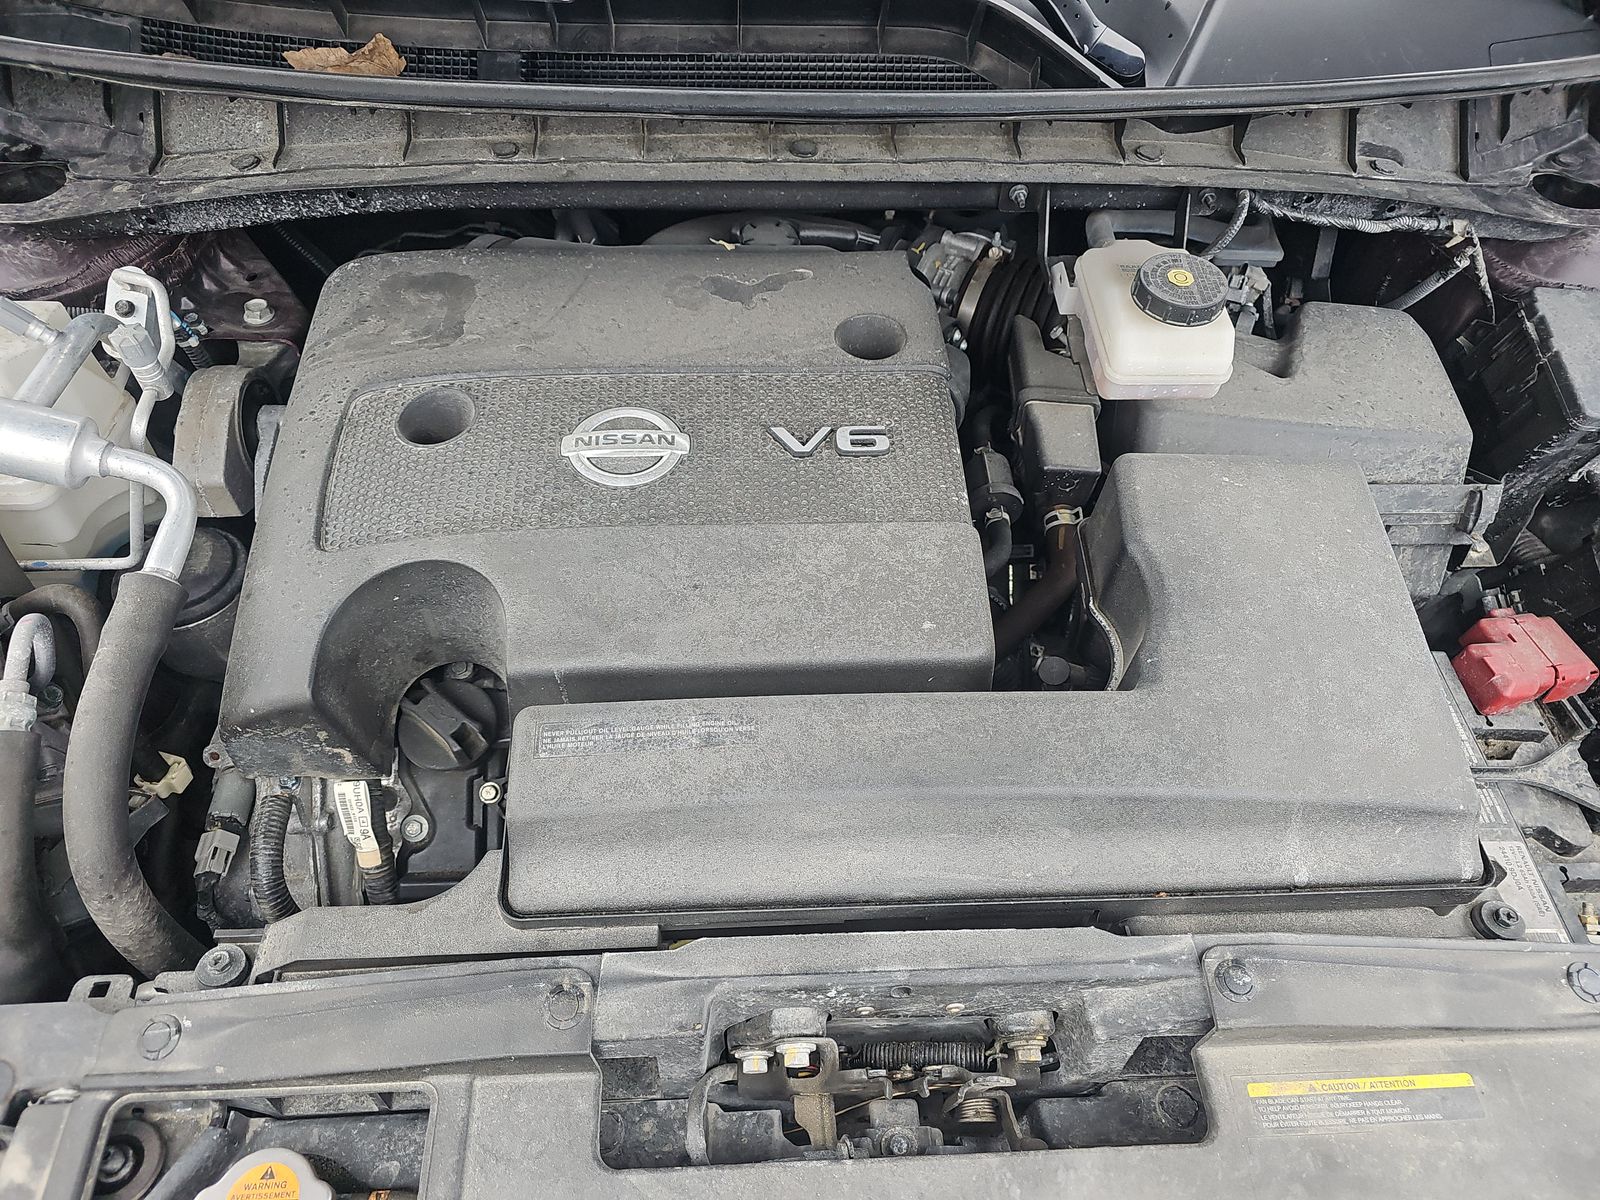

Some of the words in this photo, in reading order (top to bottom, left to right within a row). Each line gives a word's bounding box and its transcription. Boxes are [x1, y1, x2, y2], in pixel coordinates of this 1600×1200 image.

[573, 433, 677, 449] NISSAN
[767, 425, 891, 458] V6
[566, 728, 582, 736] PULL
[656, 722, 675, 730] WHILE
[672, 728, 697, 736] D'HUILE
[567, 740, 594, 748] MOTEUR
[360, 828, 372, 841] 9A
[1515, 845, 1535, 877] RENAULT
[1531, 879, 1552, 913] NISSAN
[1320, 1081, 1360, 1092] CAUTION
[1369, 1079, 1417, 1089] ATTENTION
[1268, 1097, 1286, 1105] BLADE
[1287, 1096, 1299, 1104] CAN
[1282, 1104, 1300, 1112] AVOID
[1371, 1107, 1386, 1115] TOUT
[1263, 1121, 1280, 1129] POUR
[1298, 1119, 1318, 1127] TOUTE
[1358, 1116, 1370, 1124] PAS
[1378, 1114, 1413, 1122] APPROCHER
[1413, 1113, 1425, 1121] LES
[243, 1180, 288, 1191] WARNING
[230, 1190, 296, 1200] AVERTISSEMENT
